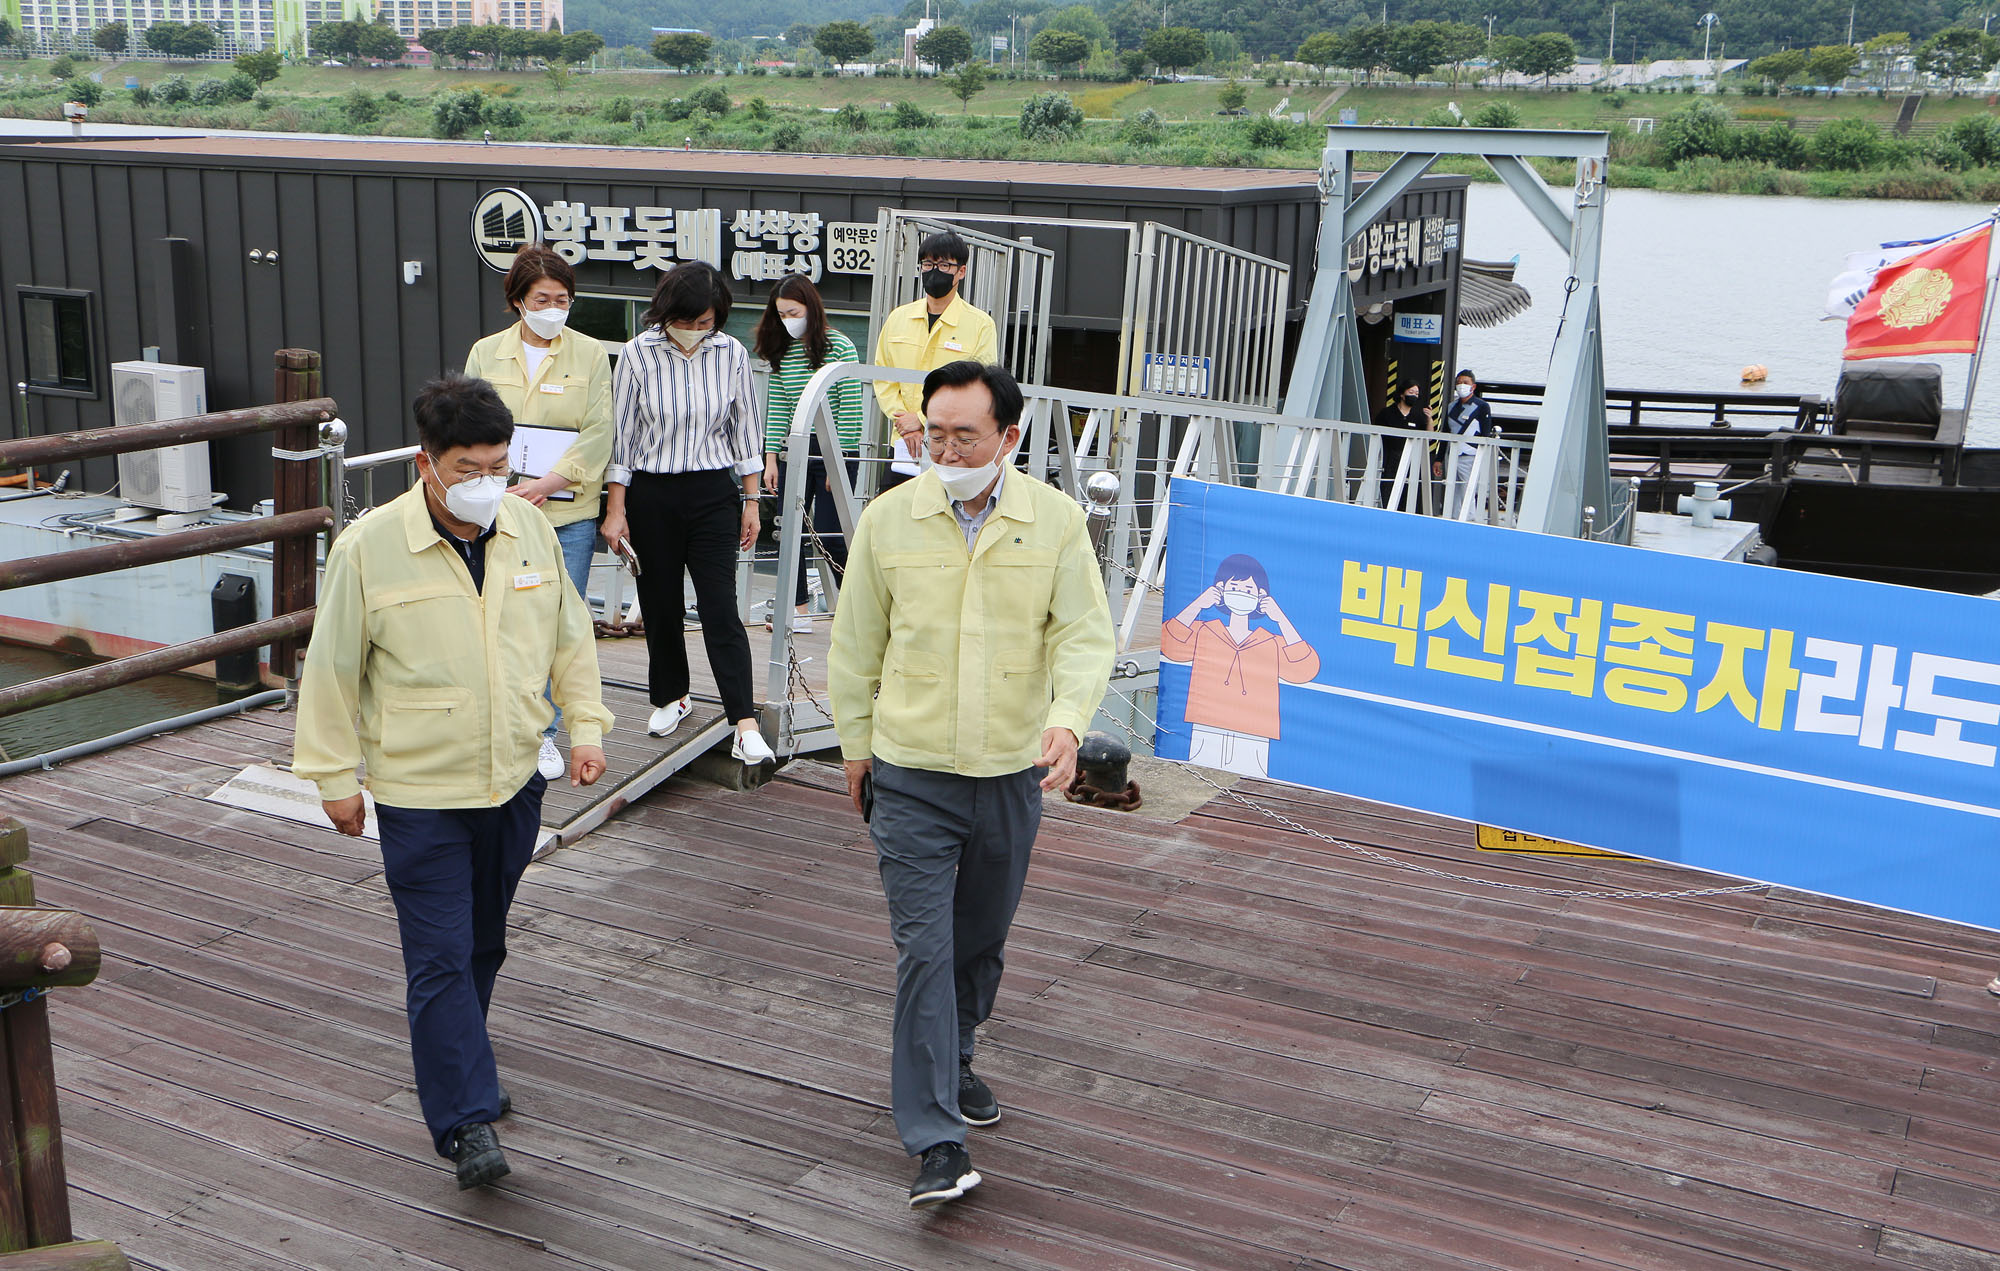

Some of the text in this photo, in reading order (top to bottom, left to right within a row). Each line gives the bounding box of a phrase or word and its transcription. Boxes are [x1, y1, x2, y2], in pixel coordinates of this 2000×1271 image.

[543, 200, 721, 272] 황포돛배
[730, 210, 823, 252] 선착장
[1368, 219, 1421, 275] 황포돛배
[1424, 216, 1444, 243] 선착장
[1401, 317, 1435, 329] 매표소
[1340, 560, 2000, 767] 백신접종자라도
